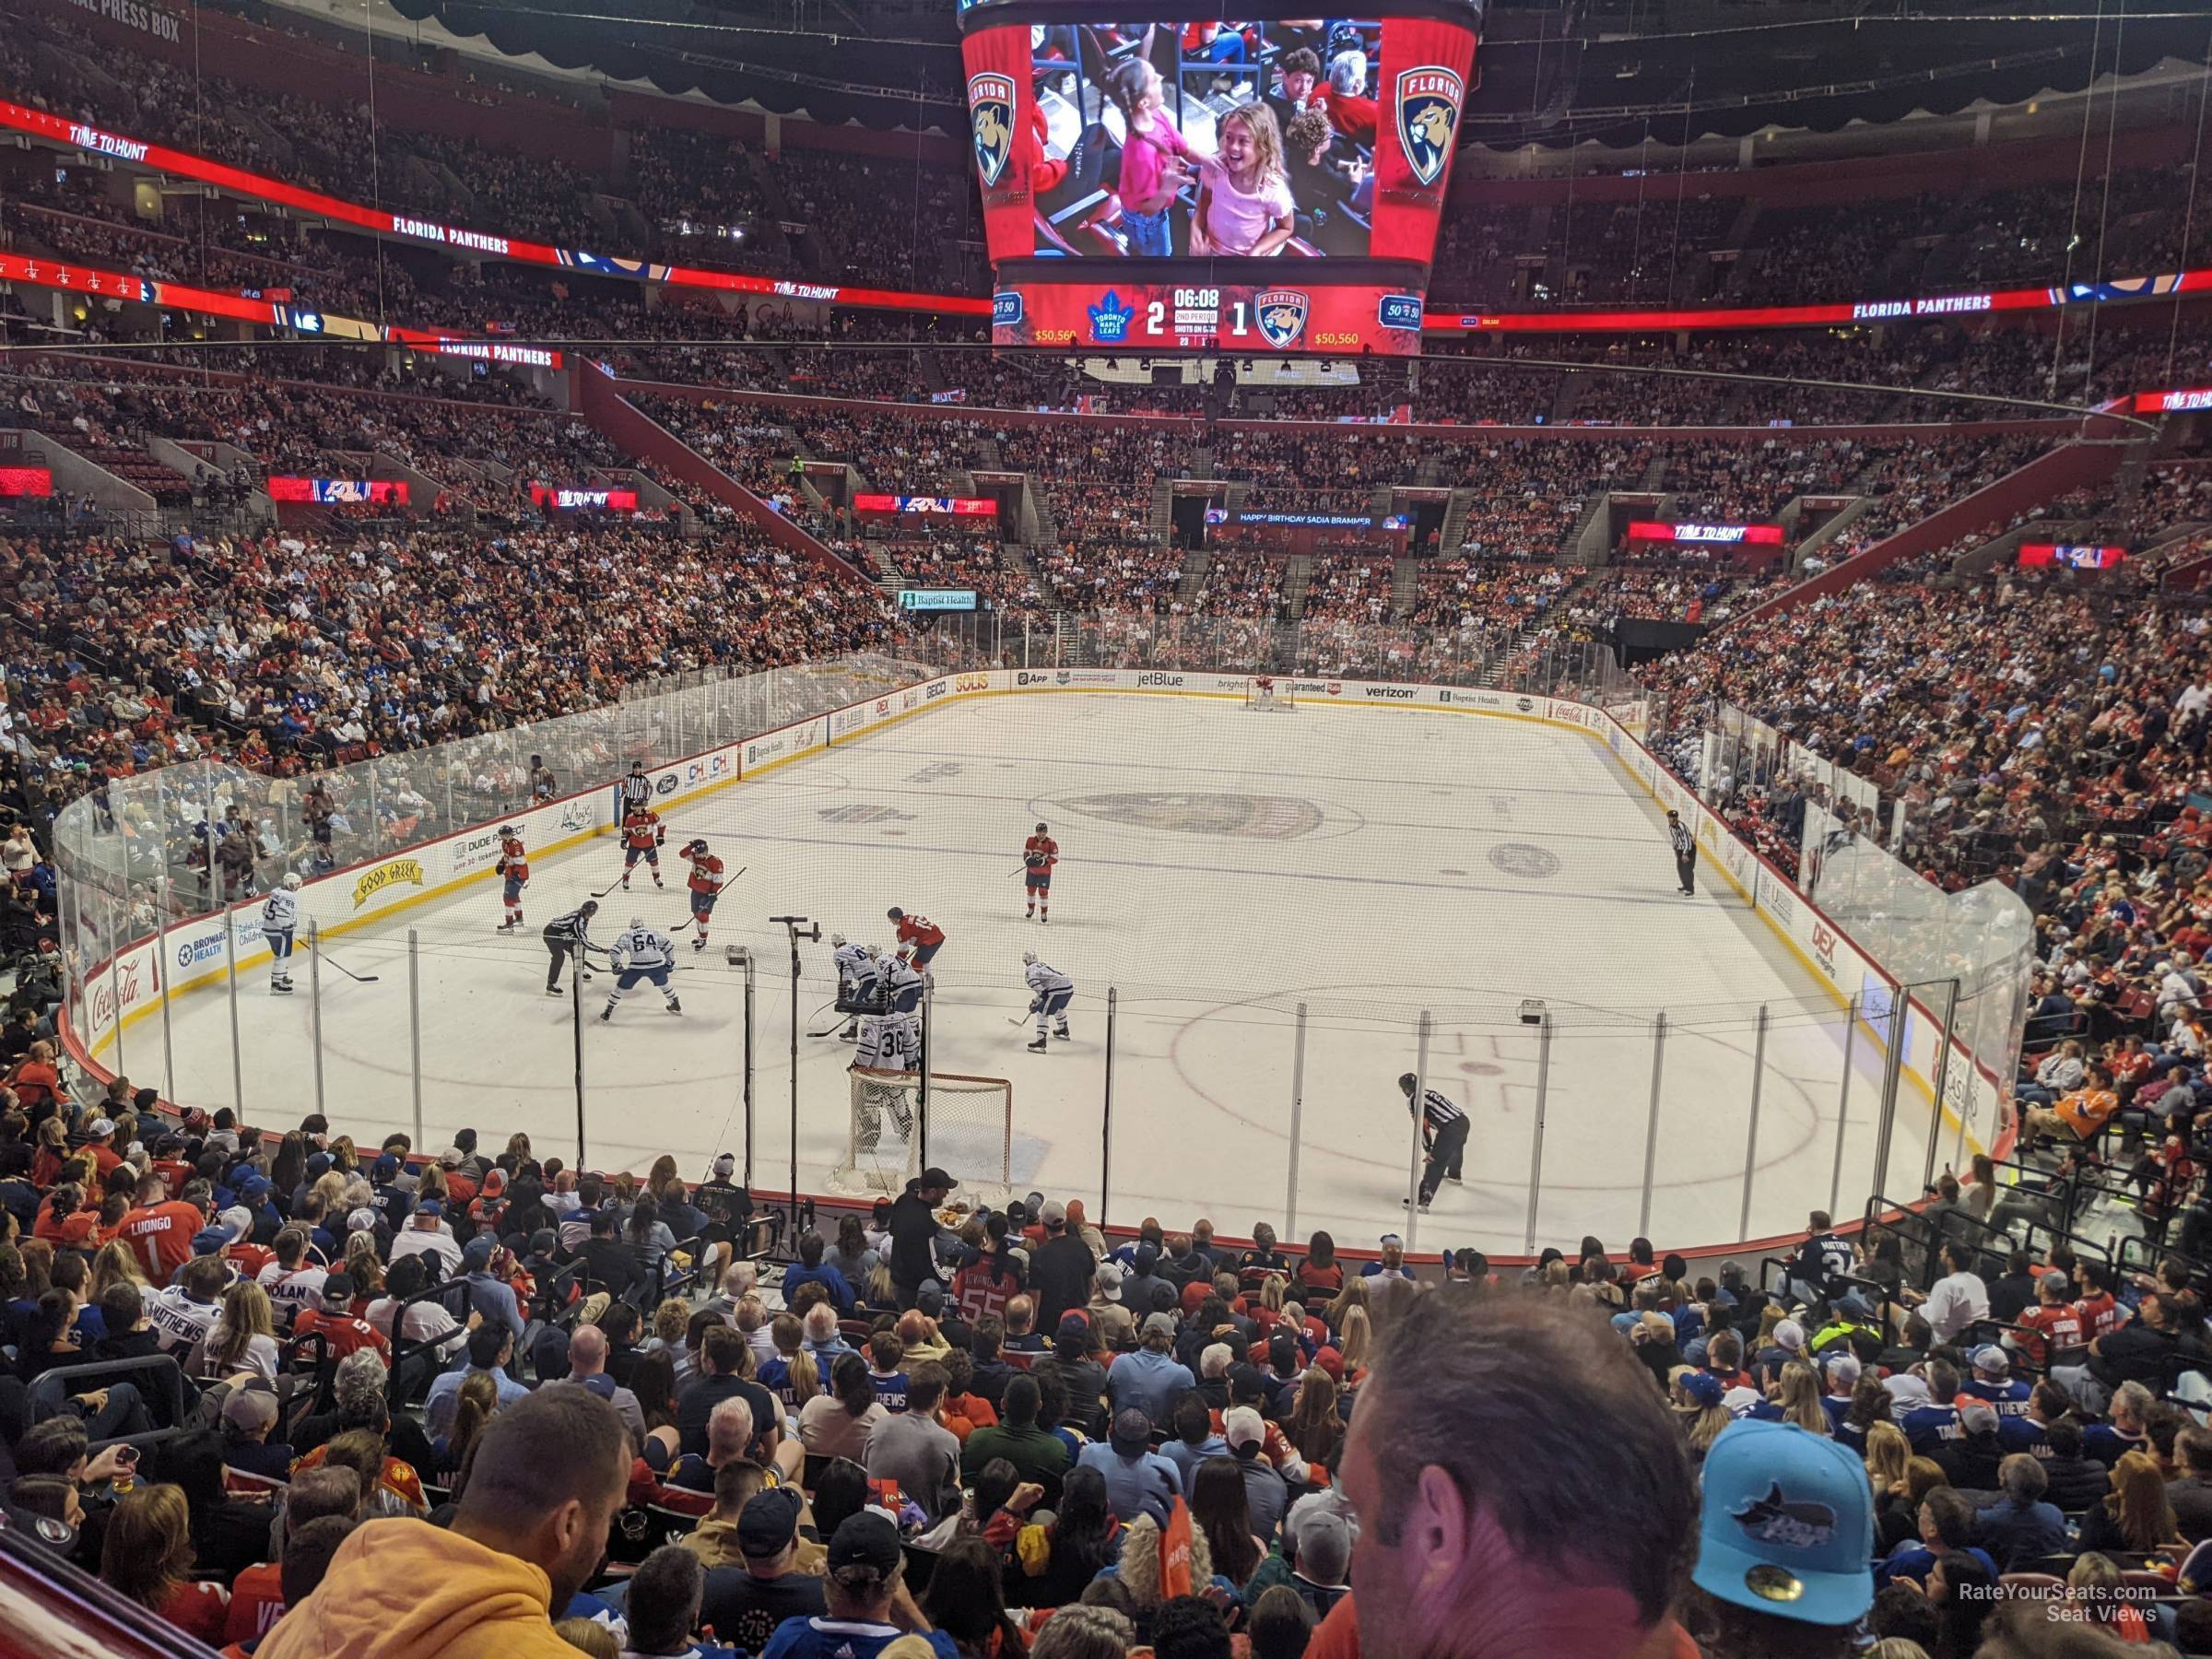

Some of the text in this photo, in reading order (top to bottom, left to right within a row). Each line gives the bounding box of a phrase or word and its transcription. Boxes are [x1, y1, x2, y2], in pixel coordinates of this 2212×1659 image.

[100, 0, 179, 43] PRESS BOX
[1409, 77, 1459, 103] FLORIDA
[70, 125, 148, 161] TIME TO HUNT
[394, 217, 508, 254] FLORIDA PANTHERS
[774, 281, 839, 300] TIME TO HUNT
[1174, 289, 1219, 307] 06:08
[1262, 295, 1301, 306] FLORIDA
[1853, 295, 1991, 318] FLORIDA PANTHERS
[1095, 313, 1126, 324] TORONTO
[1147, 302, 1165, 335] 2
[1232, 302, 1247, 335] 1
[1387, 304, 1401, 317] 50
[1035, 330, 1076, 344] $50,560
[1314, 333, 1358, 345] $50,560
[494, 346, 552, 366] PANTHERS
[2162, 392, 2186, 410] TIME
[2187, 393, 2201, 408] TO
[558, 490, 573, 506] TIME
[1240, 513, 1267, 522] HAPPY
[1267, 514, 1306, 523] BIRTHDAY
[1675, 524, 1747, 539] TIME TO HUNT
[918, 595, 971, 605] Baptist Health
[956, 673, 988, 692] SOLIS
[1137, 672, 1183, 687] jetBlue
[1285, 683, 1325, 693] guaranteed
[927, 681, 946, 699] GEICO
[1366, 687, 1413, 698] verizon
[1453, 693, 1500, 705] Baptist Health
[876, 699, 889, 713] DEX
[468, 836, 491, 853] DUDE
[360, 860, 416, 894] GOOD GREEK
[193, 931, 227, 951] BROWARD
[633, 934, 657, 952] 64
[1812, 922, 1837, 962] DEX
[194, 945, 222, 962] HEALTH
[93, 959, 140, 1032] CocaCola
[131, 1216, 171, 1236] LUONGO
[146, 1235, 162, 1276] 1
[264, 1283, 307, 1300] NOLAN
[962, 1288, 1006, 1327] 55
[152, 1304, 205, 1343] MATTHEWS
[352, 1318, 371, 1335] 5
[746, 1620, 765, 1637] 76
